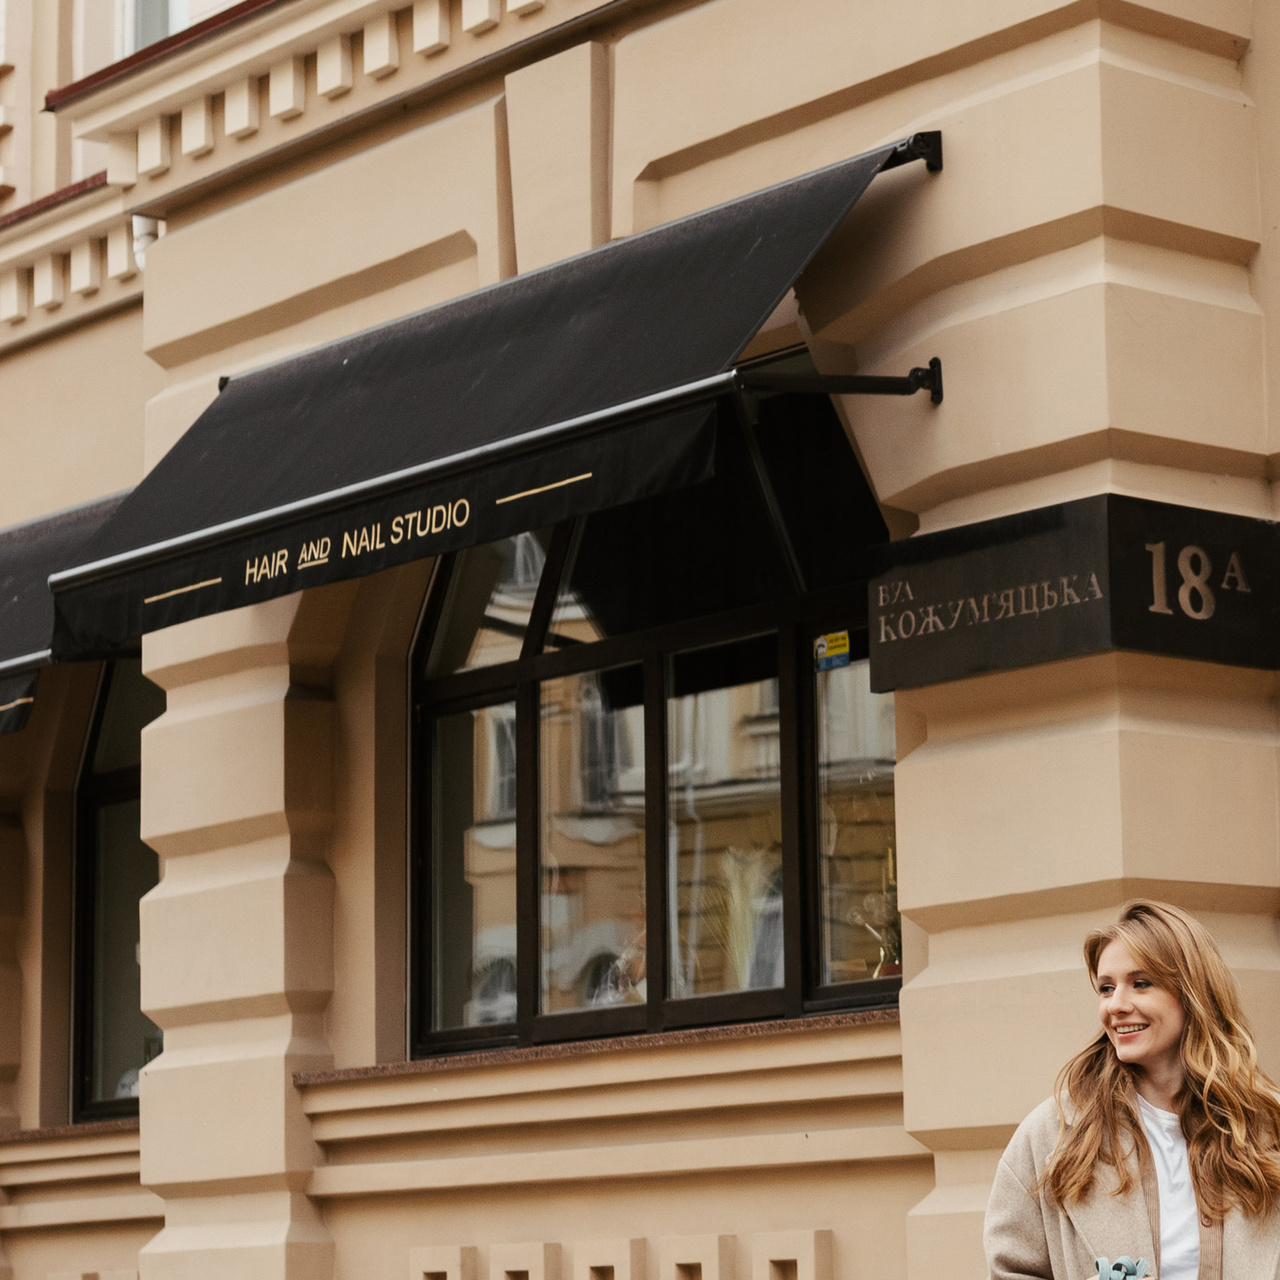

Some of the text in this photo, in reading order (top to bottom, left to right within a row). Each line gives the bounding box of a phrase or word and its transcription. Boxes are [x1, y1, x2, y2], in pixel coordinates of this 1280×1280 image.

[245, 499, 470, 587] HAIR AND NAIL STUDIO
